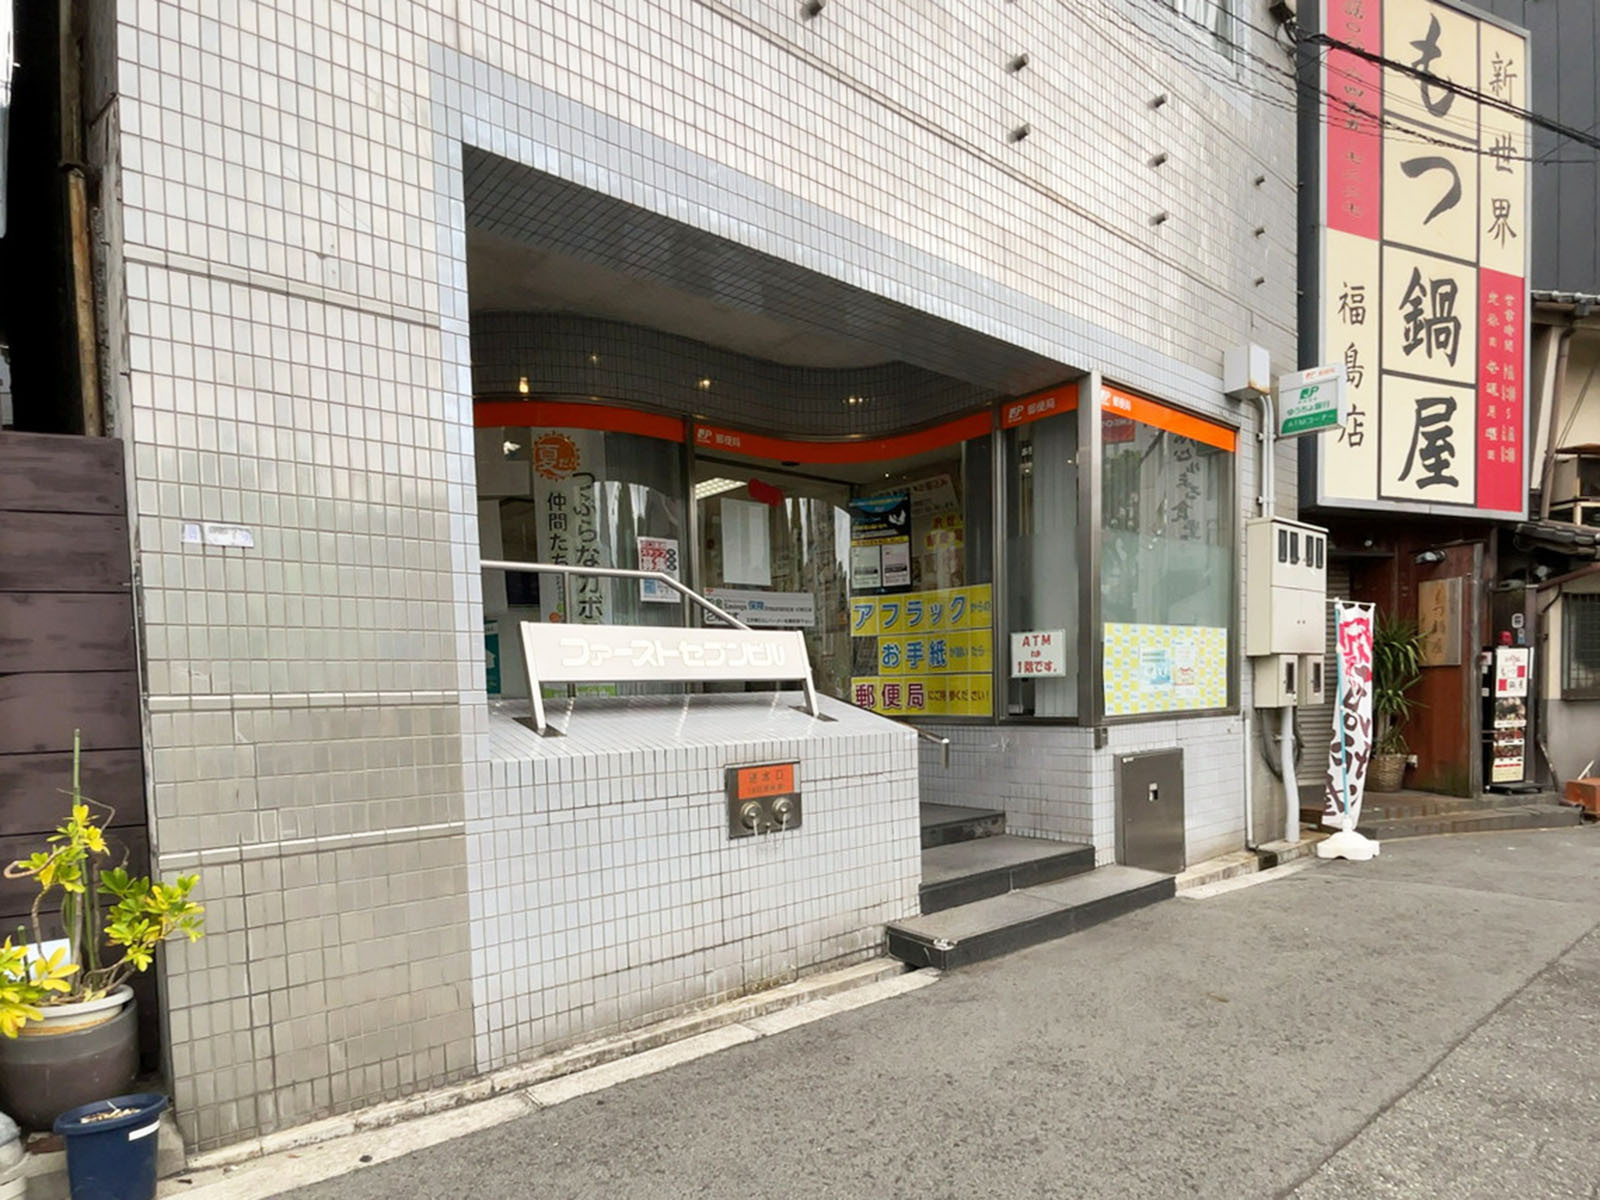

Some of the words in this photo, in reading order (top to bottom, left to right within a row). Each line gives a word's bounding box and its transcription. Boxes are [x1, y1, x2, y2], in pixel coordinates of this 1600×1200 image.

[1487, 51, 1518, 248] 新世界
[1398, 12, 1462, 489] もつ鍋屋
[1338, 281, 1366, 447] 福島店
[548, 492, 568, 565] 仲間たち
[559, 637, 786, 667] ファーストセブンビル
[1022, 634, 1051, 647] ATM
